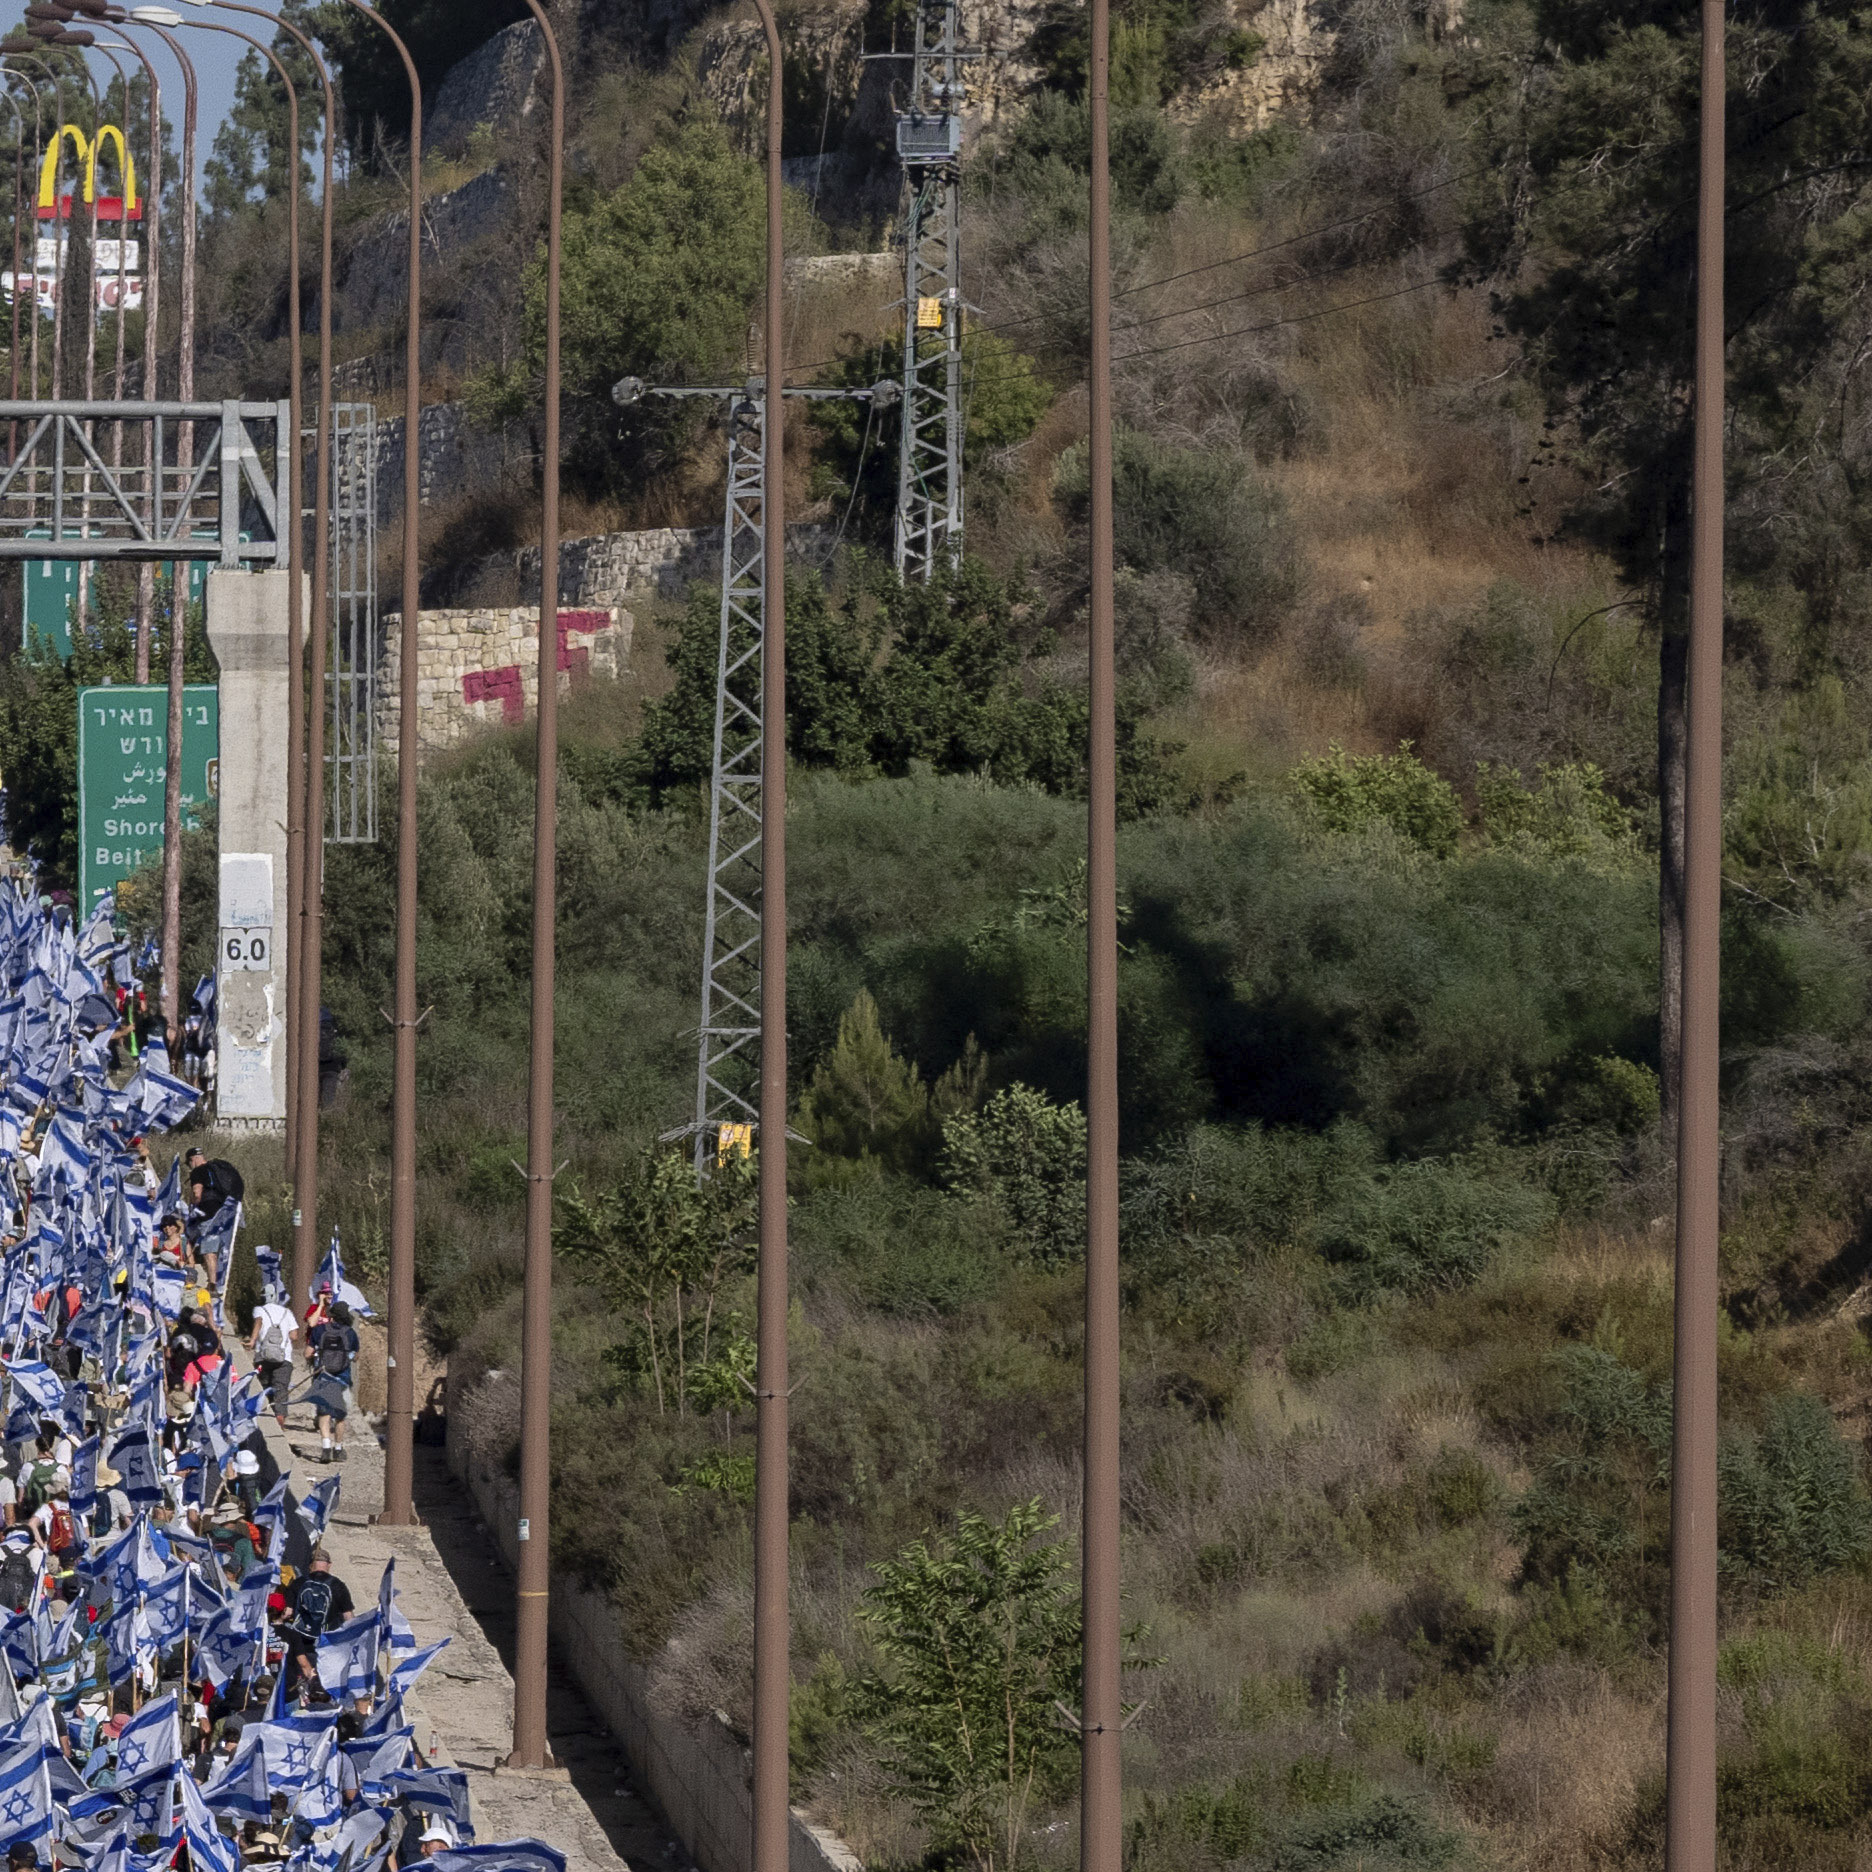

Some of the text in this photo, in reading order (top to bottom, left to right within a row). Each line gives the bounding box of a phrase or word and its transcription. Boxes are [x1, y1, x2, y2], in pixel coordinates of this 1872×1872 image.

[93, 706, 153, 727] מאיר
[120, 736, 162, 755] ורש
[104, 819, 201, 837] Shoreh
[95, 847, 142, 865] Beit
[226, 938, 266, 961] 6.0
